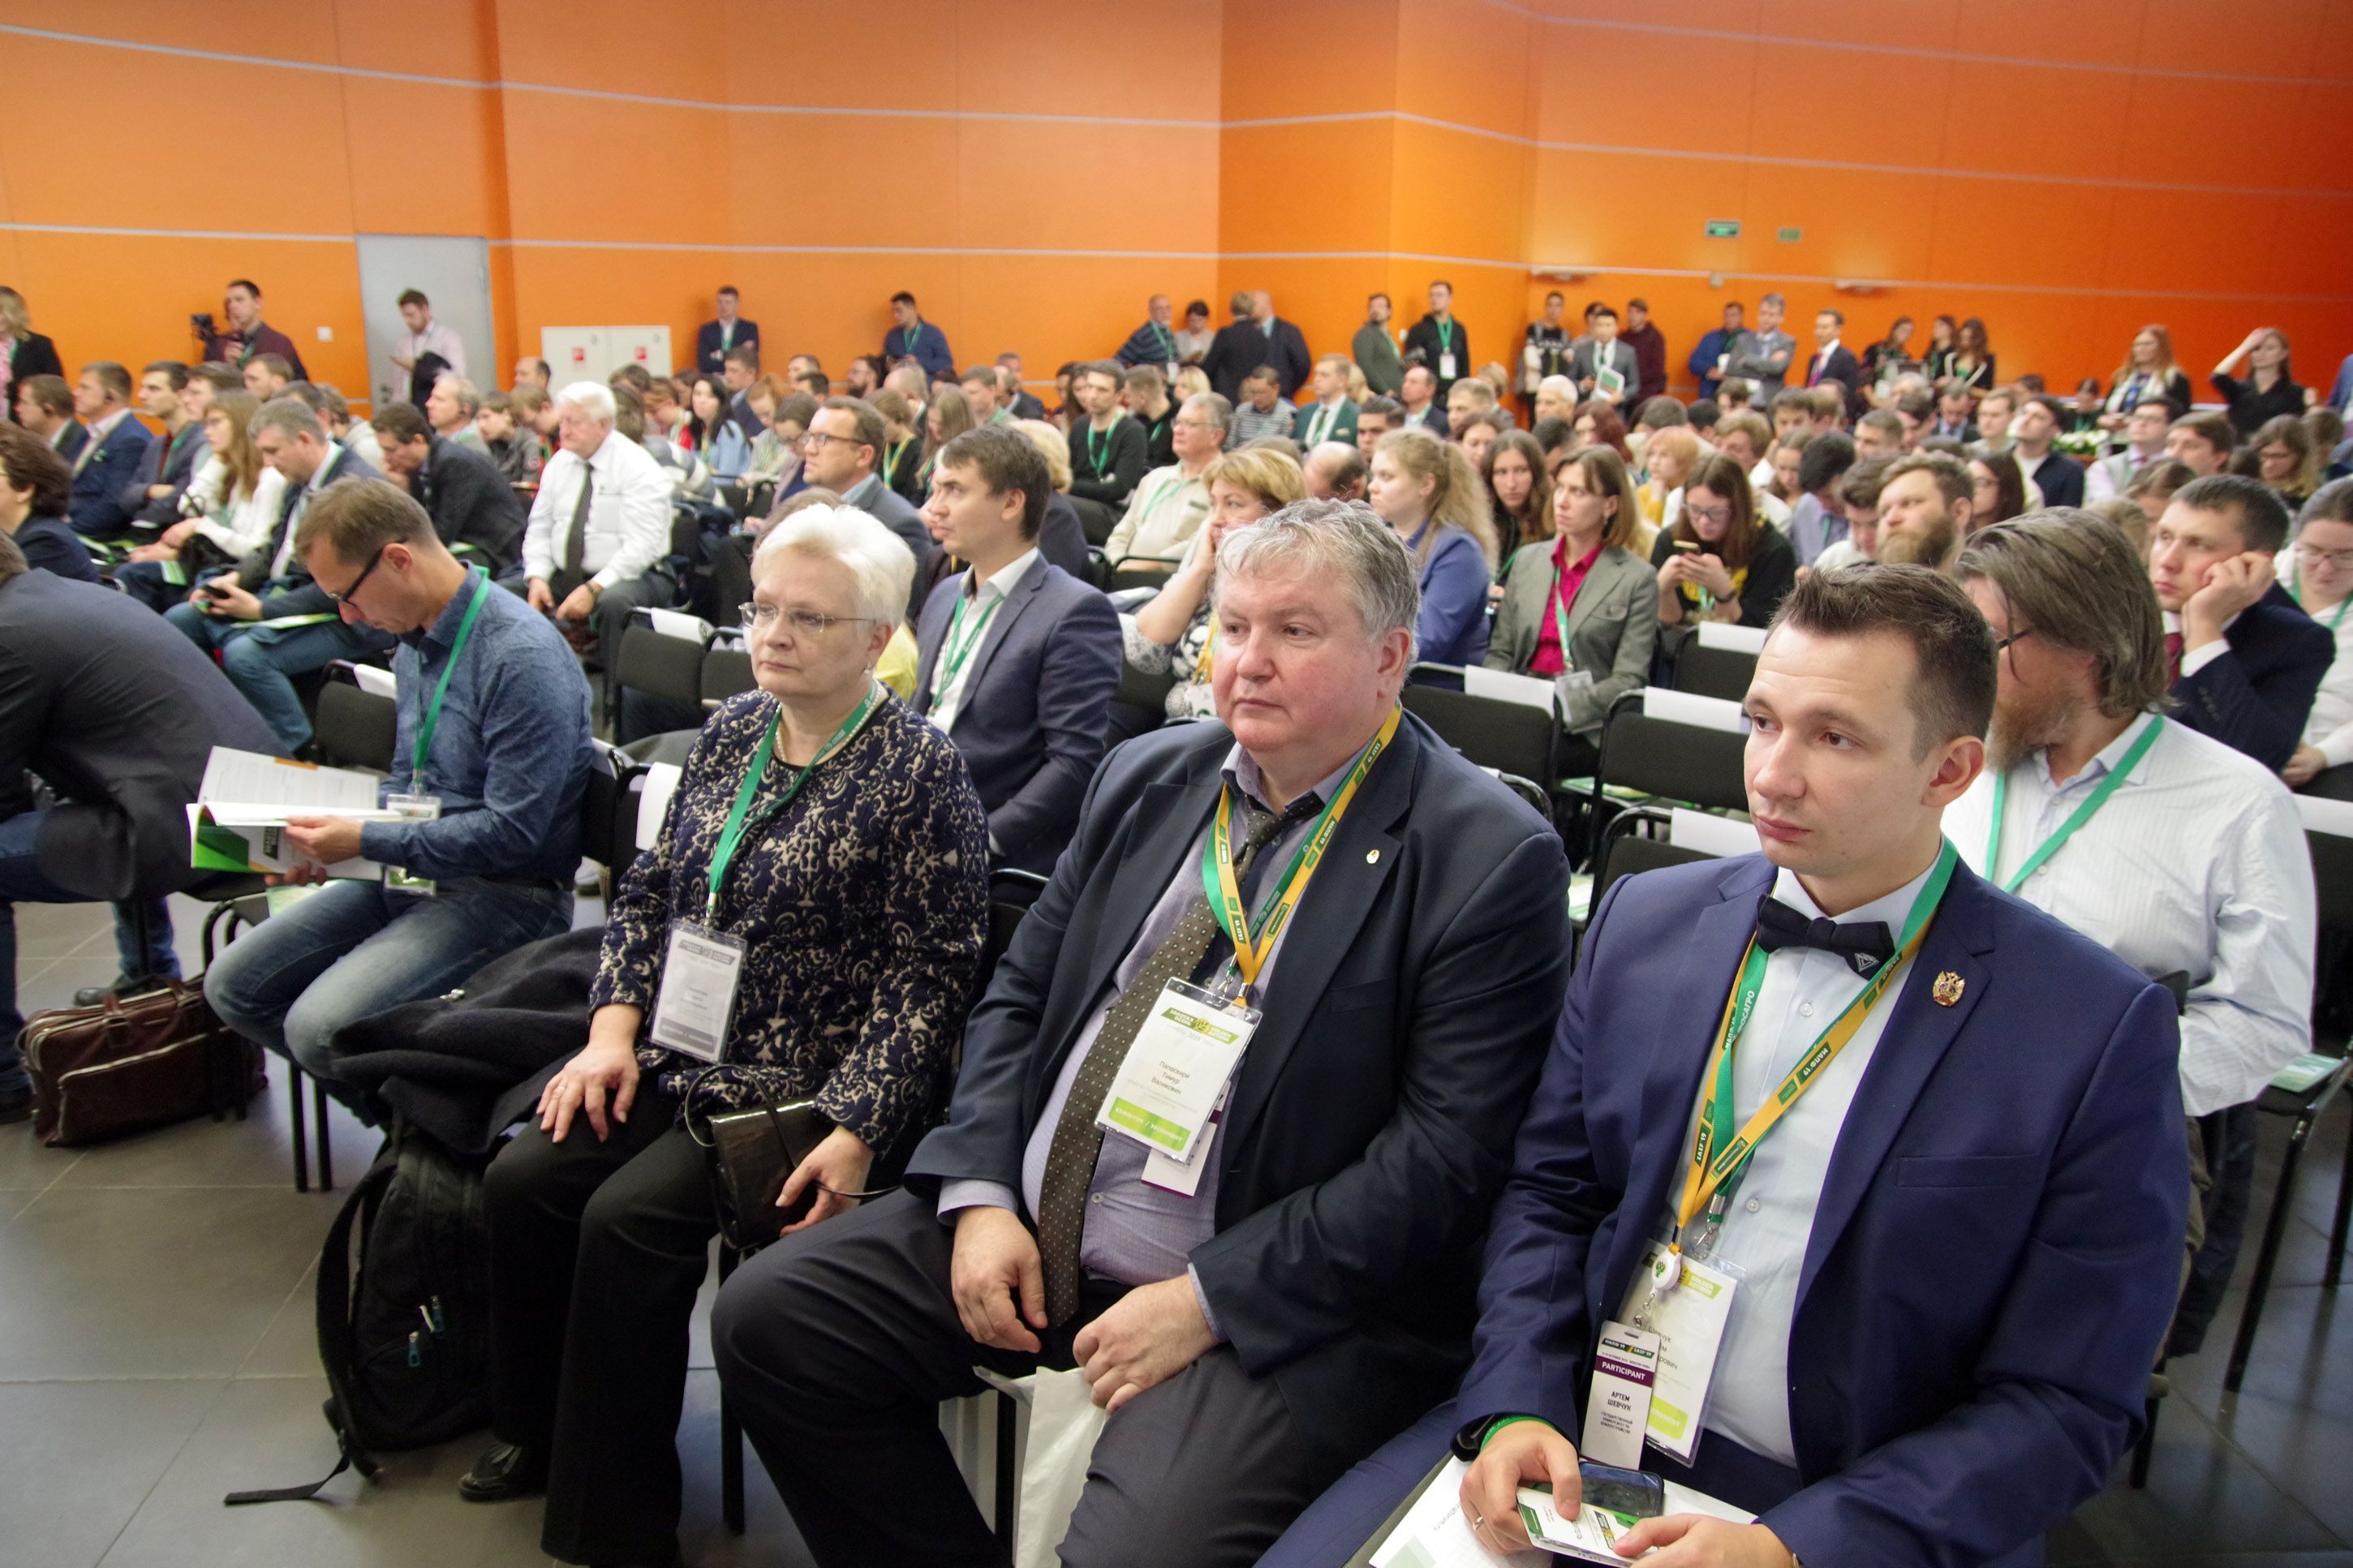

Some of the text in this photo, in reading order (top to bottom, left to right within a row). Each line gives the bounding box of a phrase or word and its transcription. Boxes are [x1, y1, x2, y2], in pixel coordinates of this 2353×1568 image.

[1602, 1360, 1645, 1381] PARTICIPANT
[1611, 1390, 1630, 1402] АРТЕМ
[1607, 1398, 1632, 1411] ШЕВЧУК
